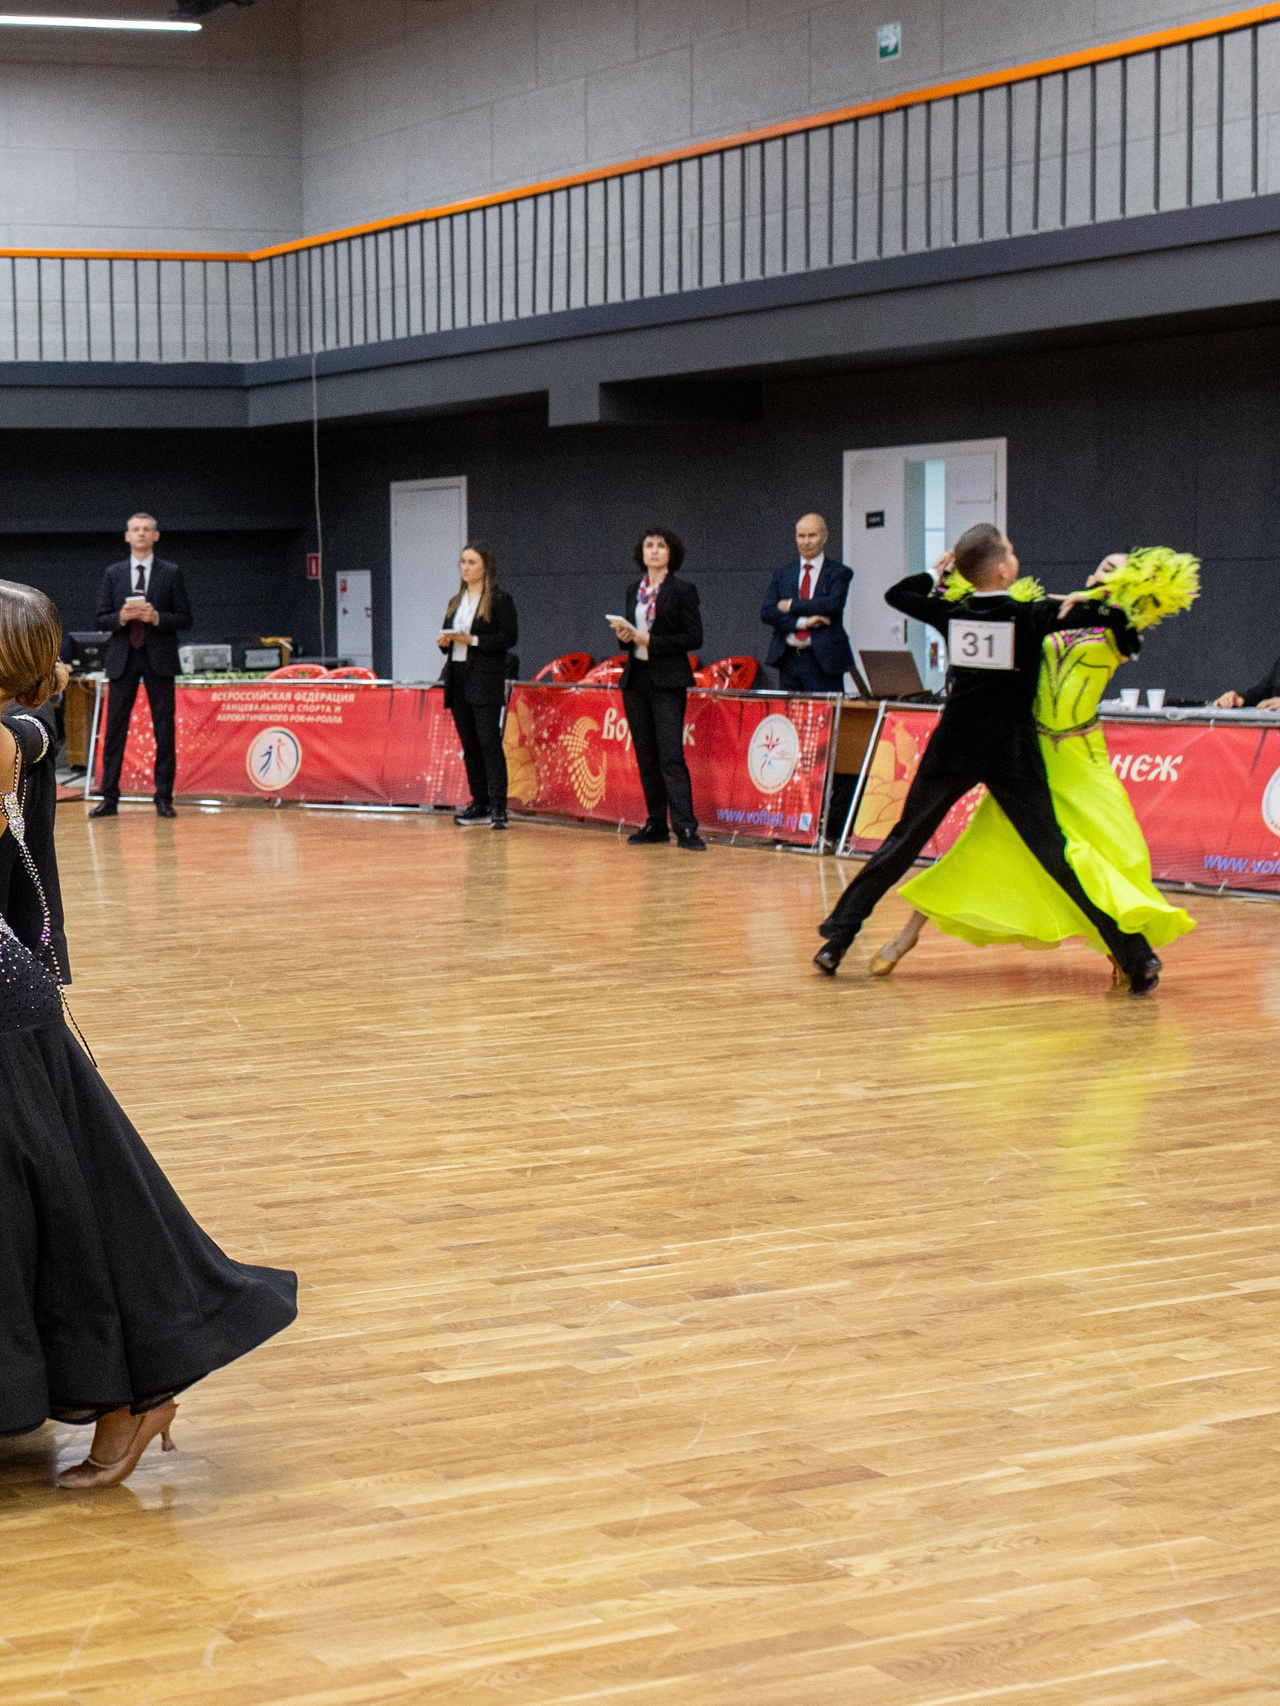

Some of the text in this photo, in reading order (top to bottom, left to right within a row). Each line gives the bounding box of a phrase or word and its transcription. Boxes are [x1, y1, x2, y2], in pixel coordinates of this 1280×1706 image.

[962, 632, 994, 658] 31
[211, 691, 356, 704] ВСЕРОССИЙСКАЯ ФЕДЕРАЦИЯ
[297, 704, 332, 714] СПОРТА
